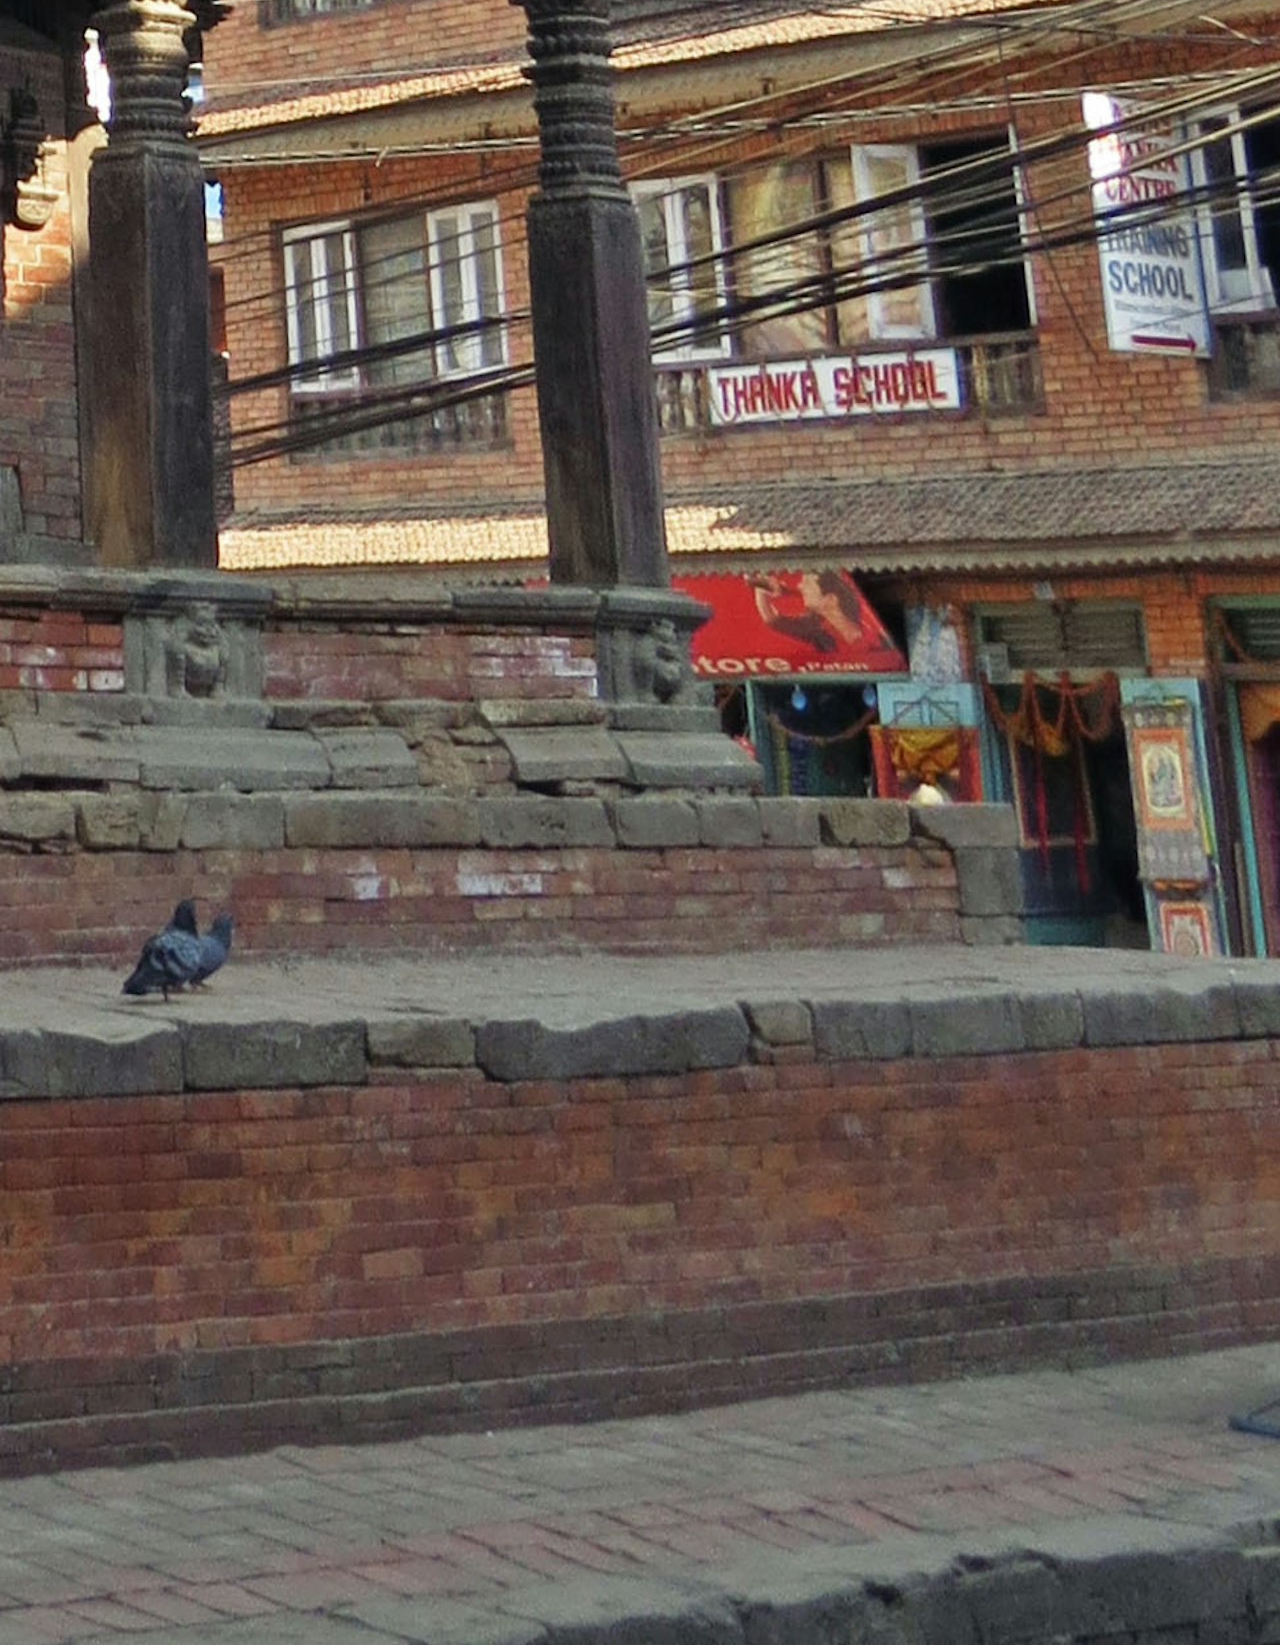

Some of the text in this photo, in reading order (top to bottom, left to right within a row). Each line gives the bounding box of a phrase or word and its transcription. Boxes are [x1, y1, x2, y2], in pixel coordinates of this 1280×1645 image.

[1108, 260, 1194, 302] SCHOOL
[717, 359, 948, 418] THANKA SCHOOL
[691, 655, 790, 674] tore
